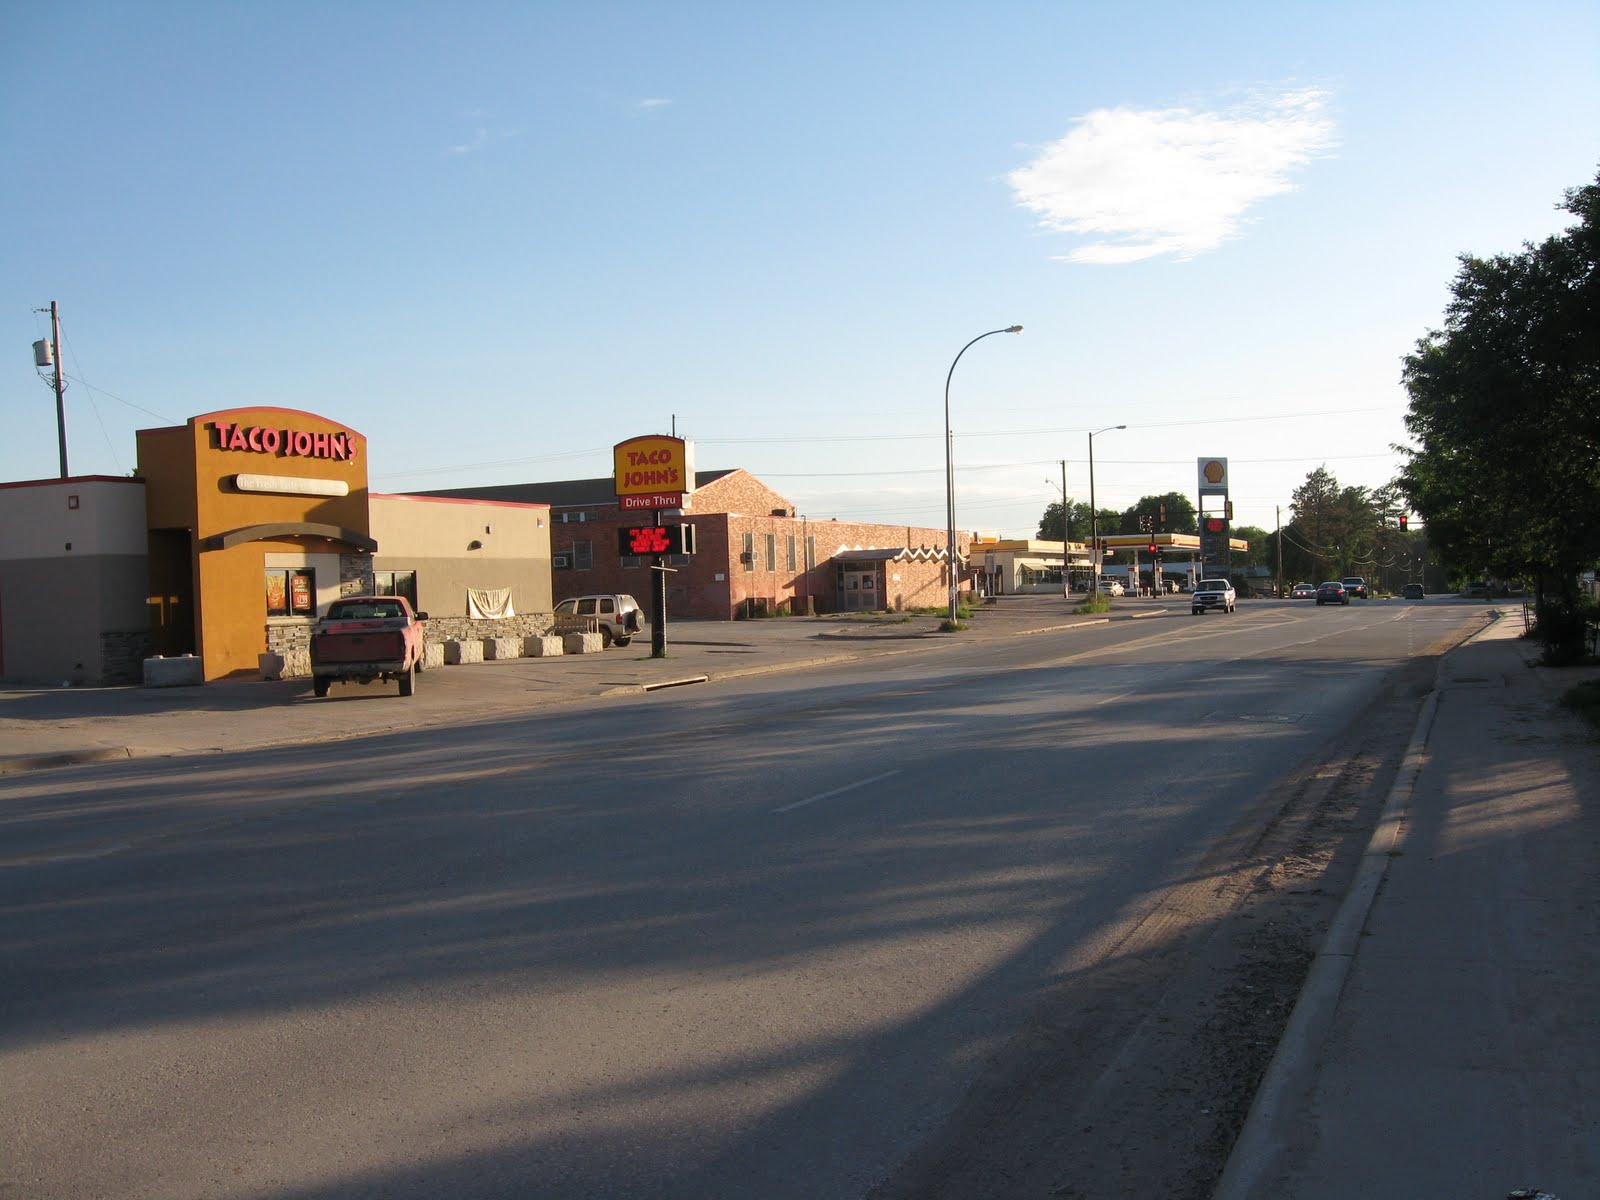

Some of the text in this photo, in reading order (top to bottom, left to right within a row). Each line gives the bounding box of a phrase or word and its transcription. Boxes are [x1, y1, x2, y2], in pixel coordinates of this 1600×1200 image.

[215, 422, 357, 460] TACO JOHN'S
[627, 449, 672, 466] TACO
[624, 467, 678, 488] JOHN'S
[625, 496, 676, 508] Drive Thru
